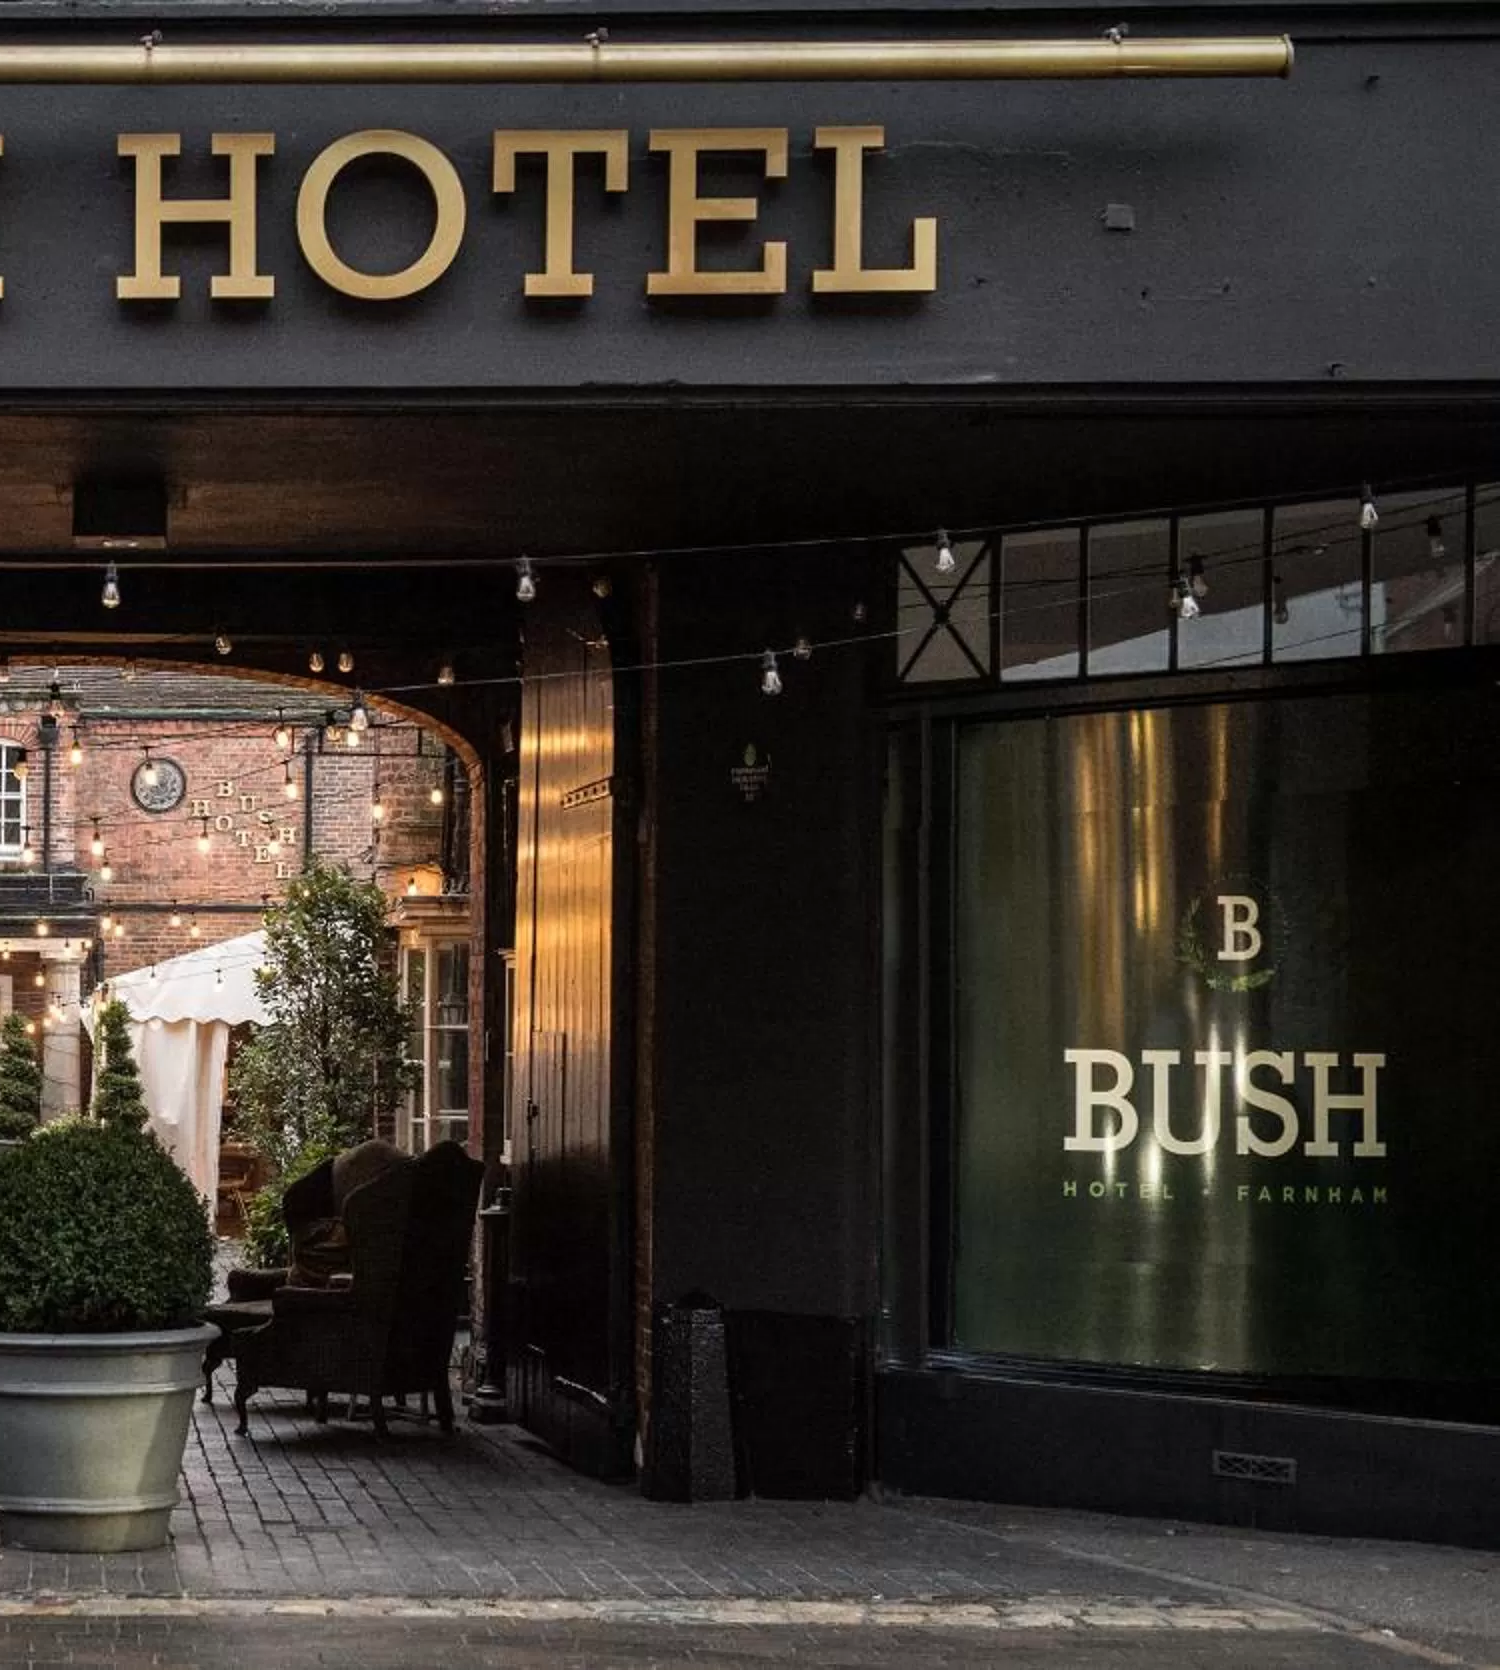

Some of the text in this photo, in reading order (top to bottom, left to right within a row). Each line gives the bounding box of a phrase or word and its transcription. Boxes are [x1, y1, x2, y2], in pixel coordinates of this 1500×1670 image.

[115, 125, 937, 302] HOTEL
[192, 799, 292, 879] HOTEL
[217, 781, 296, 844] BUSH
[1217, 895, 1262, 961] B
[1064, 1049, 1387, 1158] BUSH
[1063, 1181, 1388, 1202] HOTEL FARNHAM
